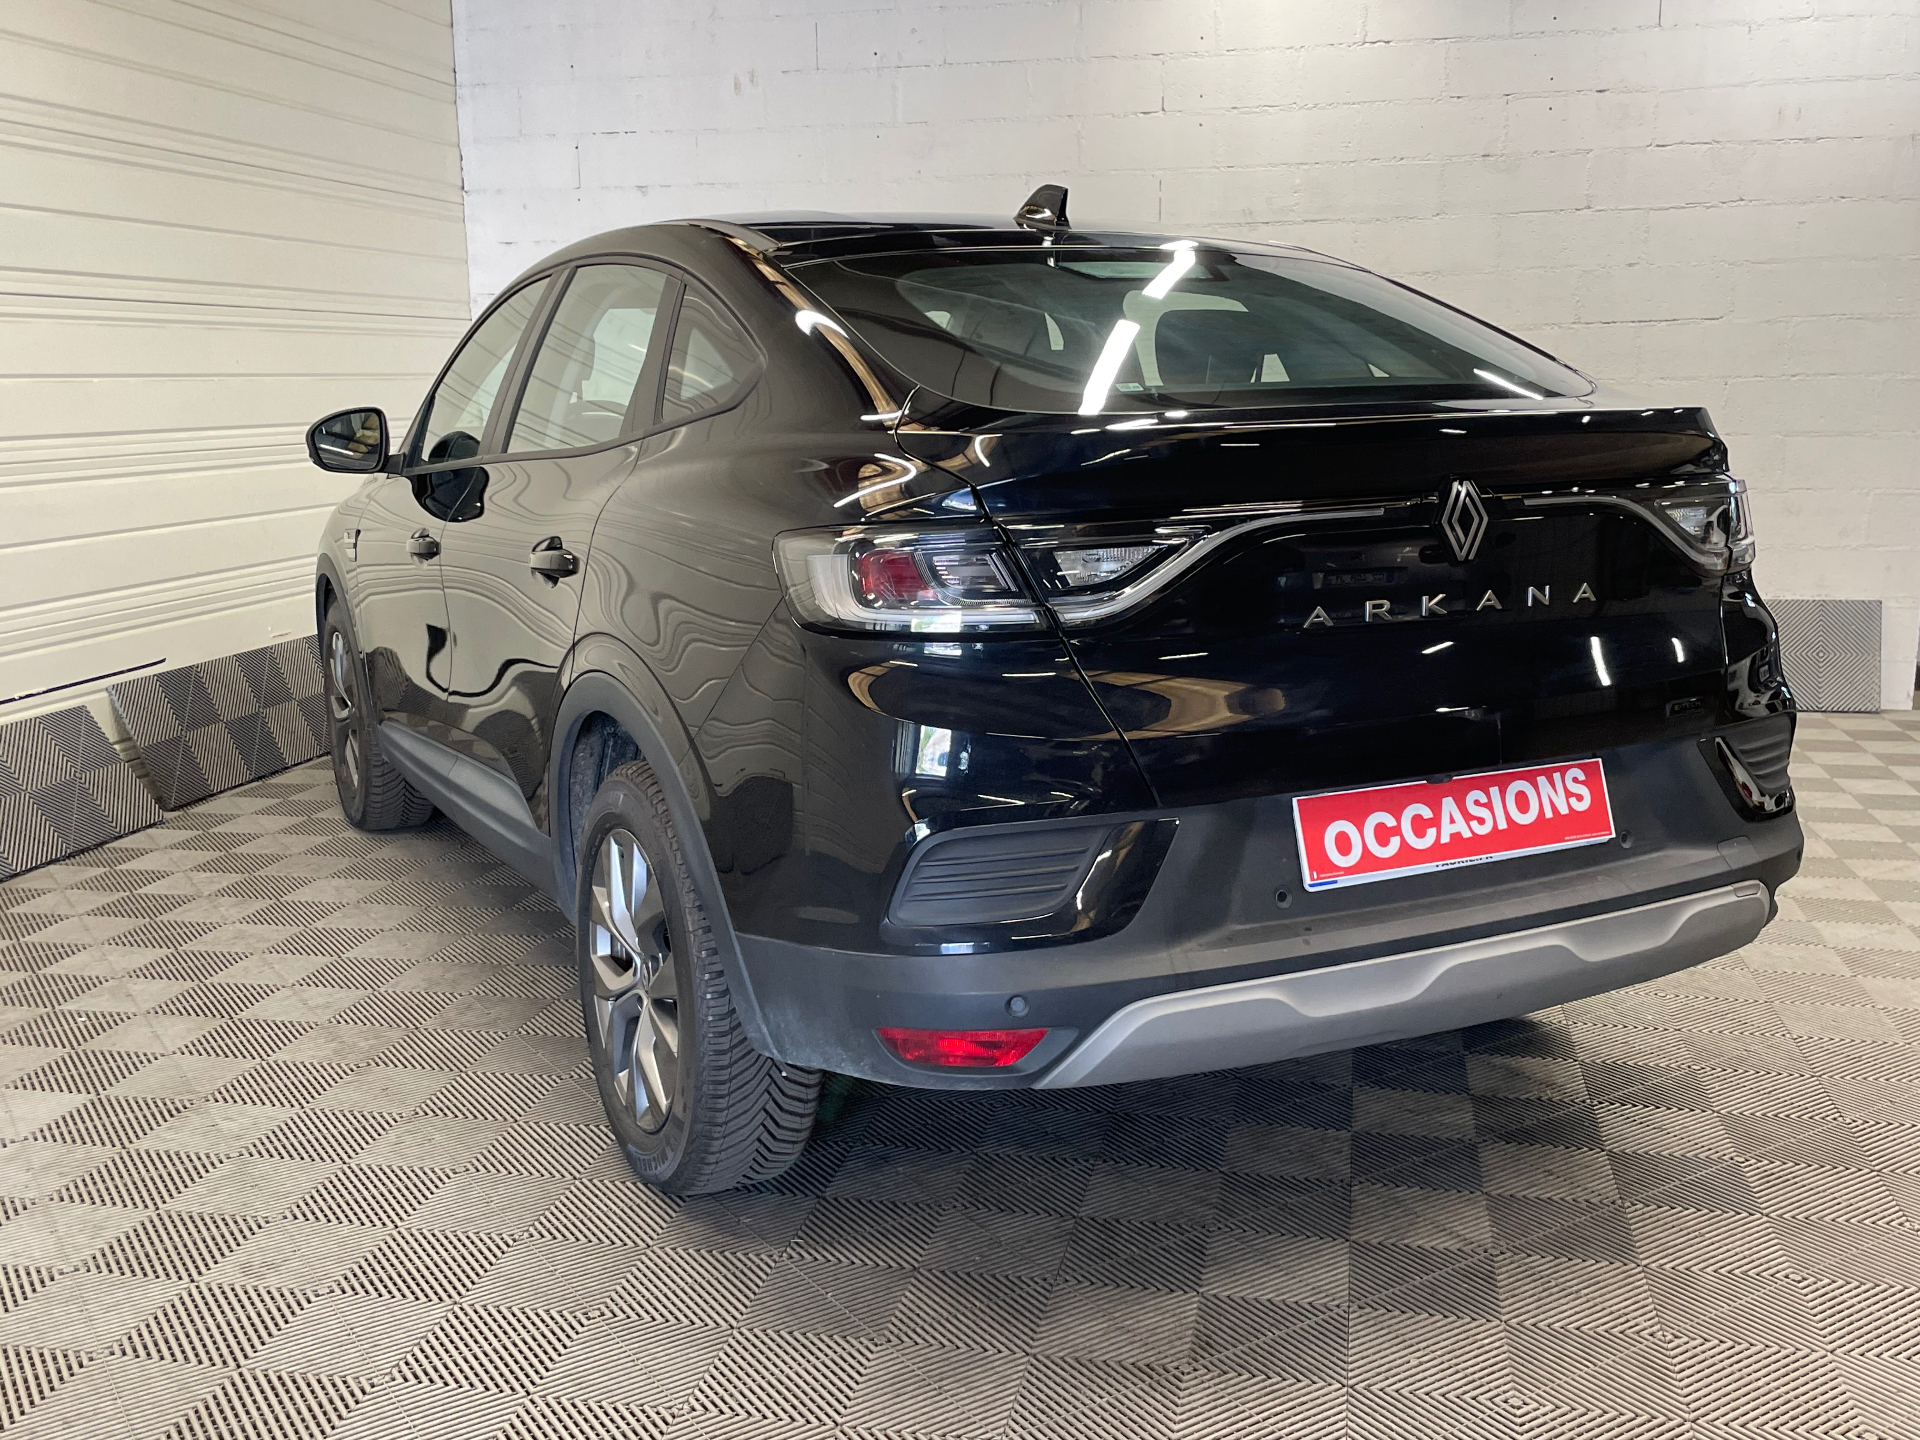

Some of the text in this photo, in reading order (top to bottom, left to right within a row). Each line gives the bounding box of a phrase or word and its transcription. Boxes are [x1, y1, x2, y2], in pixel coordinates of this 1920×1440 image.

[1303, 582, 1597, 629] ARKANA
[1323, 767, 1592, 868] OCCASIONS
[632, 1146, 669, 1172] MICHEL
